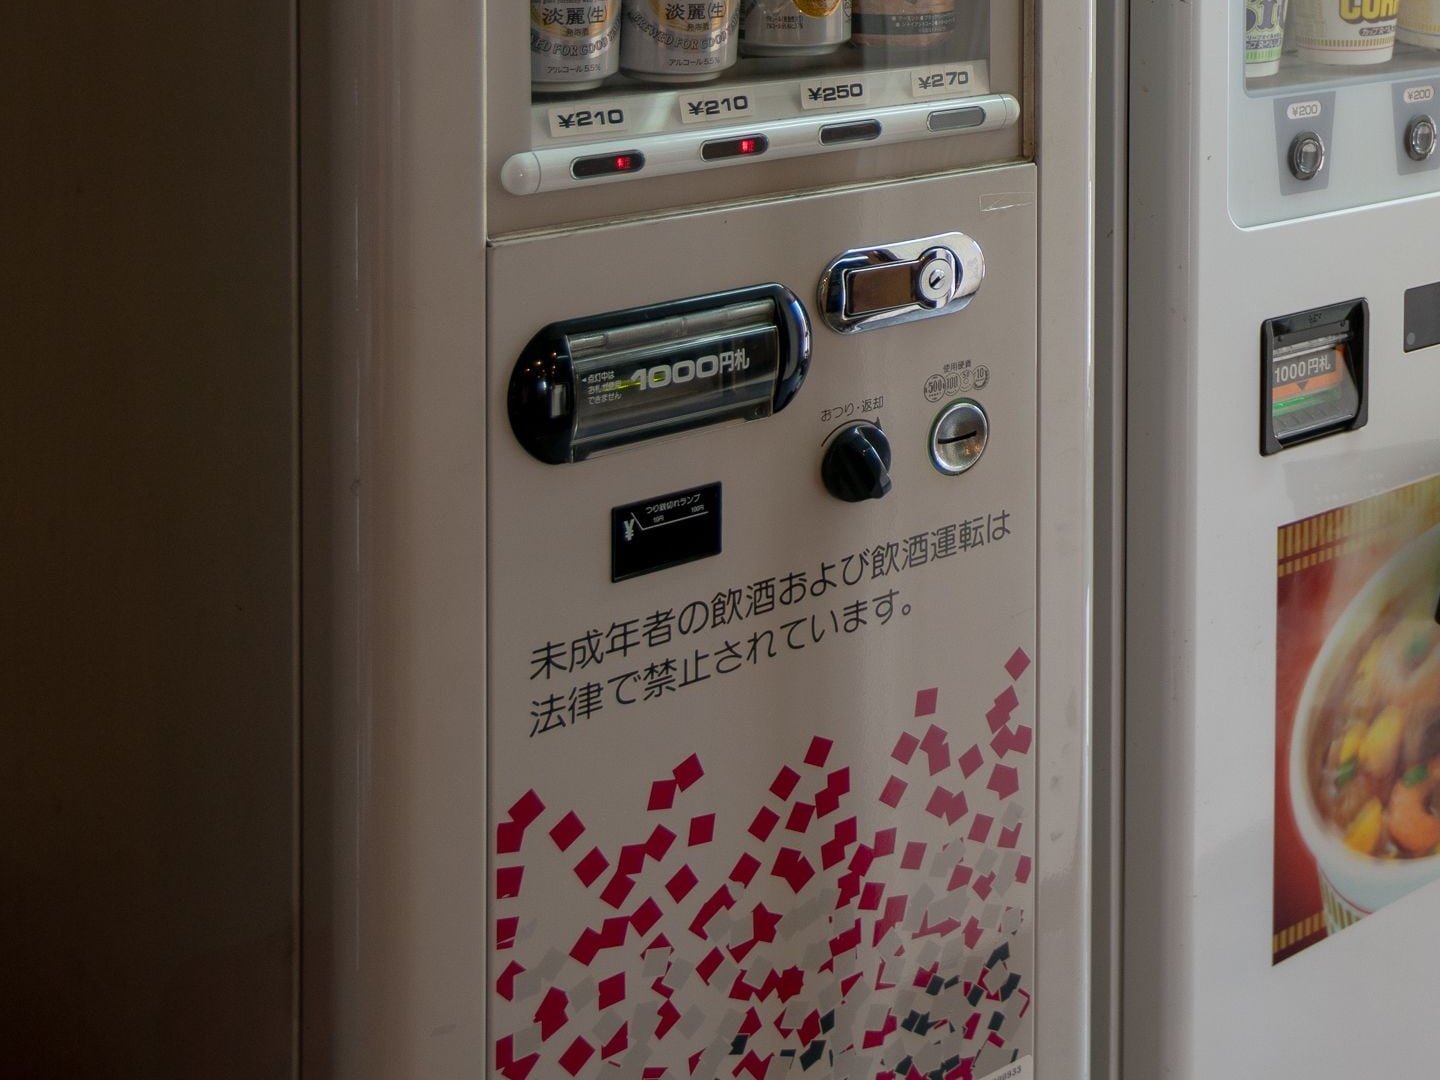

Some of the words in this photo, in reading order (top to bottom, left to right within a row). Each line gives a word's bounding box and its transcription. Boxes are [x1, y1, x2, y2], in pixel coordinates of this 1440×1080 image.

[918, 71, 970, 90] ¥270
[807, 83, 863, 102] ¥250
[1408, 88, 1431, 100] ¥200
[687, 95, 749, 116] ¥210
[1292, 103, 1318, 117] ¥200
[557, 108, 625, 129] ¥210
[630, 348, 750, 391] 1000円札
[943, 359, 972, 373] 使用硬貨
[1274, 354, 1331, 383] 1000円札
[821, 395, 884, 422] おつり・返却
[645, 493, 701, 515] つり銭切れランプ
[530, 509, 1012, 681] 未成年者の飲酒および飲酒運転は
[529, 588, 914, 738] 法律で禁止されています。
